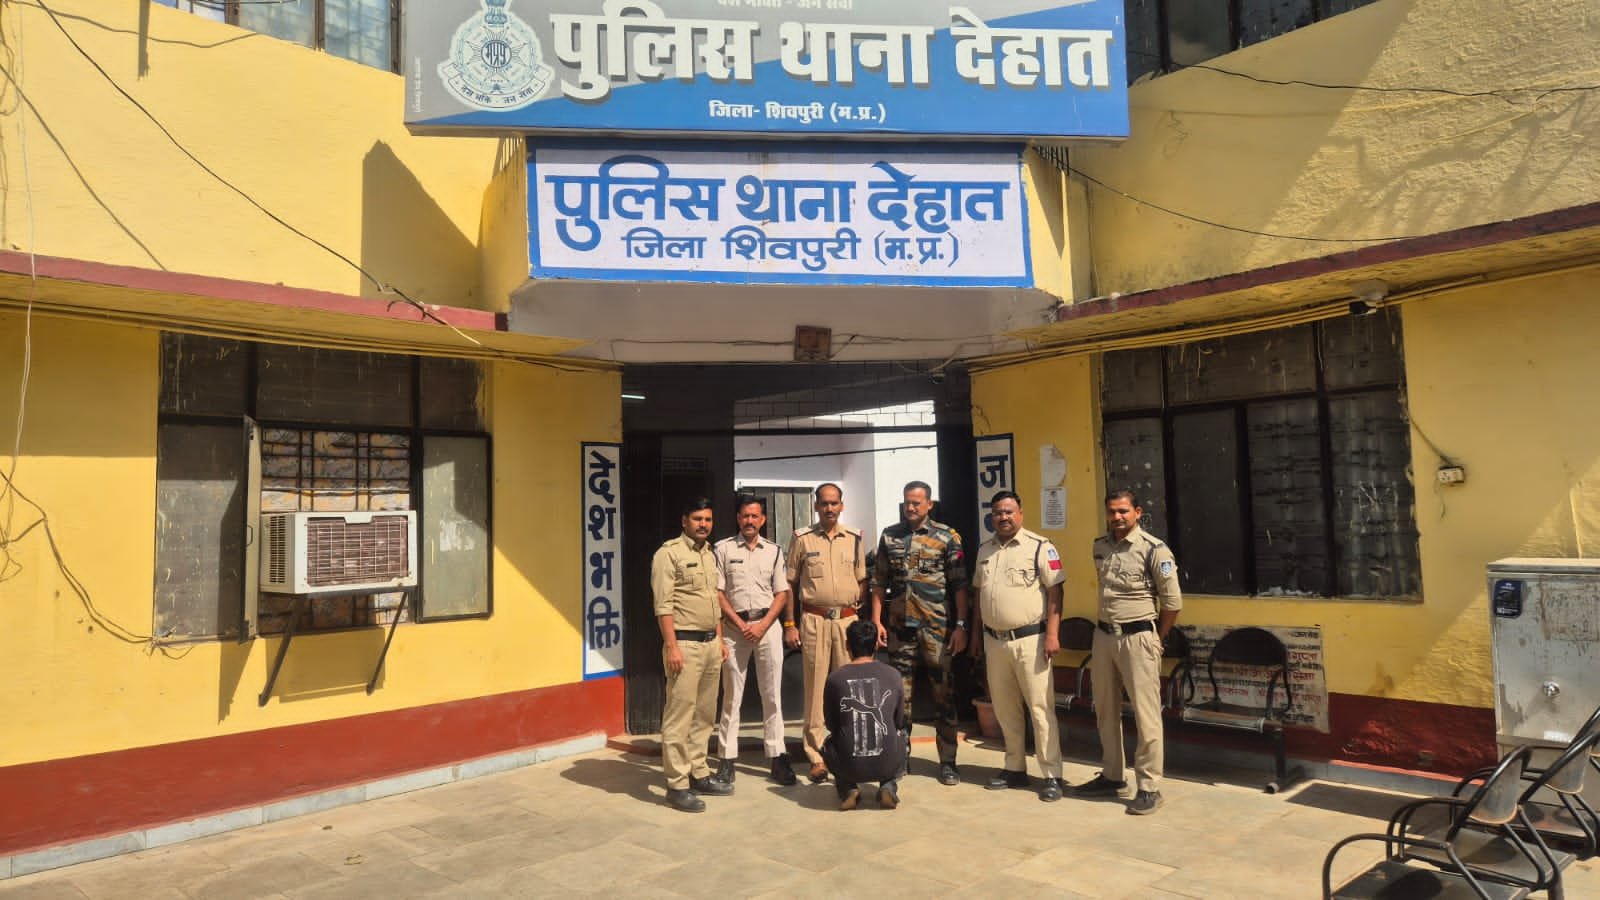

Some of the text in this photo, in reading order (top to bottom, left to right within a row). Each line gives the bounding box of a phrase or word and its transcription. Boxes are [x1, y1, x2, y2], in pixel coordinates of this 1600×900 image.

[550, 0, 1113, 101] पुलिस थाना देहात
[765, 101, 825, 124] शिवपुरी
[830, 102, 886, 124] (म.प्र.)
[544, 154, 1010, 252] पुलिस थाना देहात
[621, 224, 959, 271] जिला शिवपुरी (म.प्र.)
